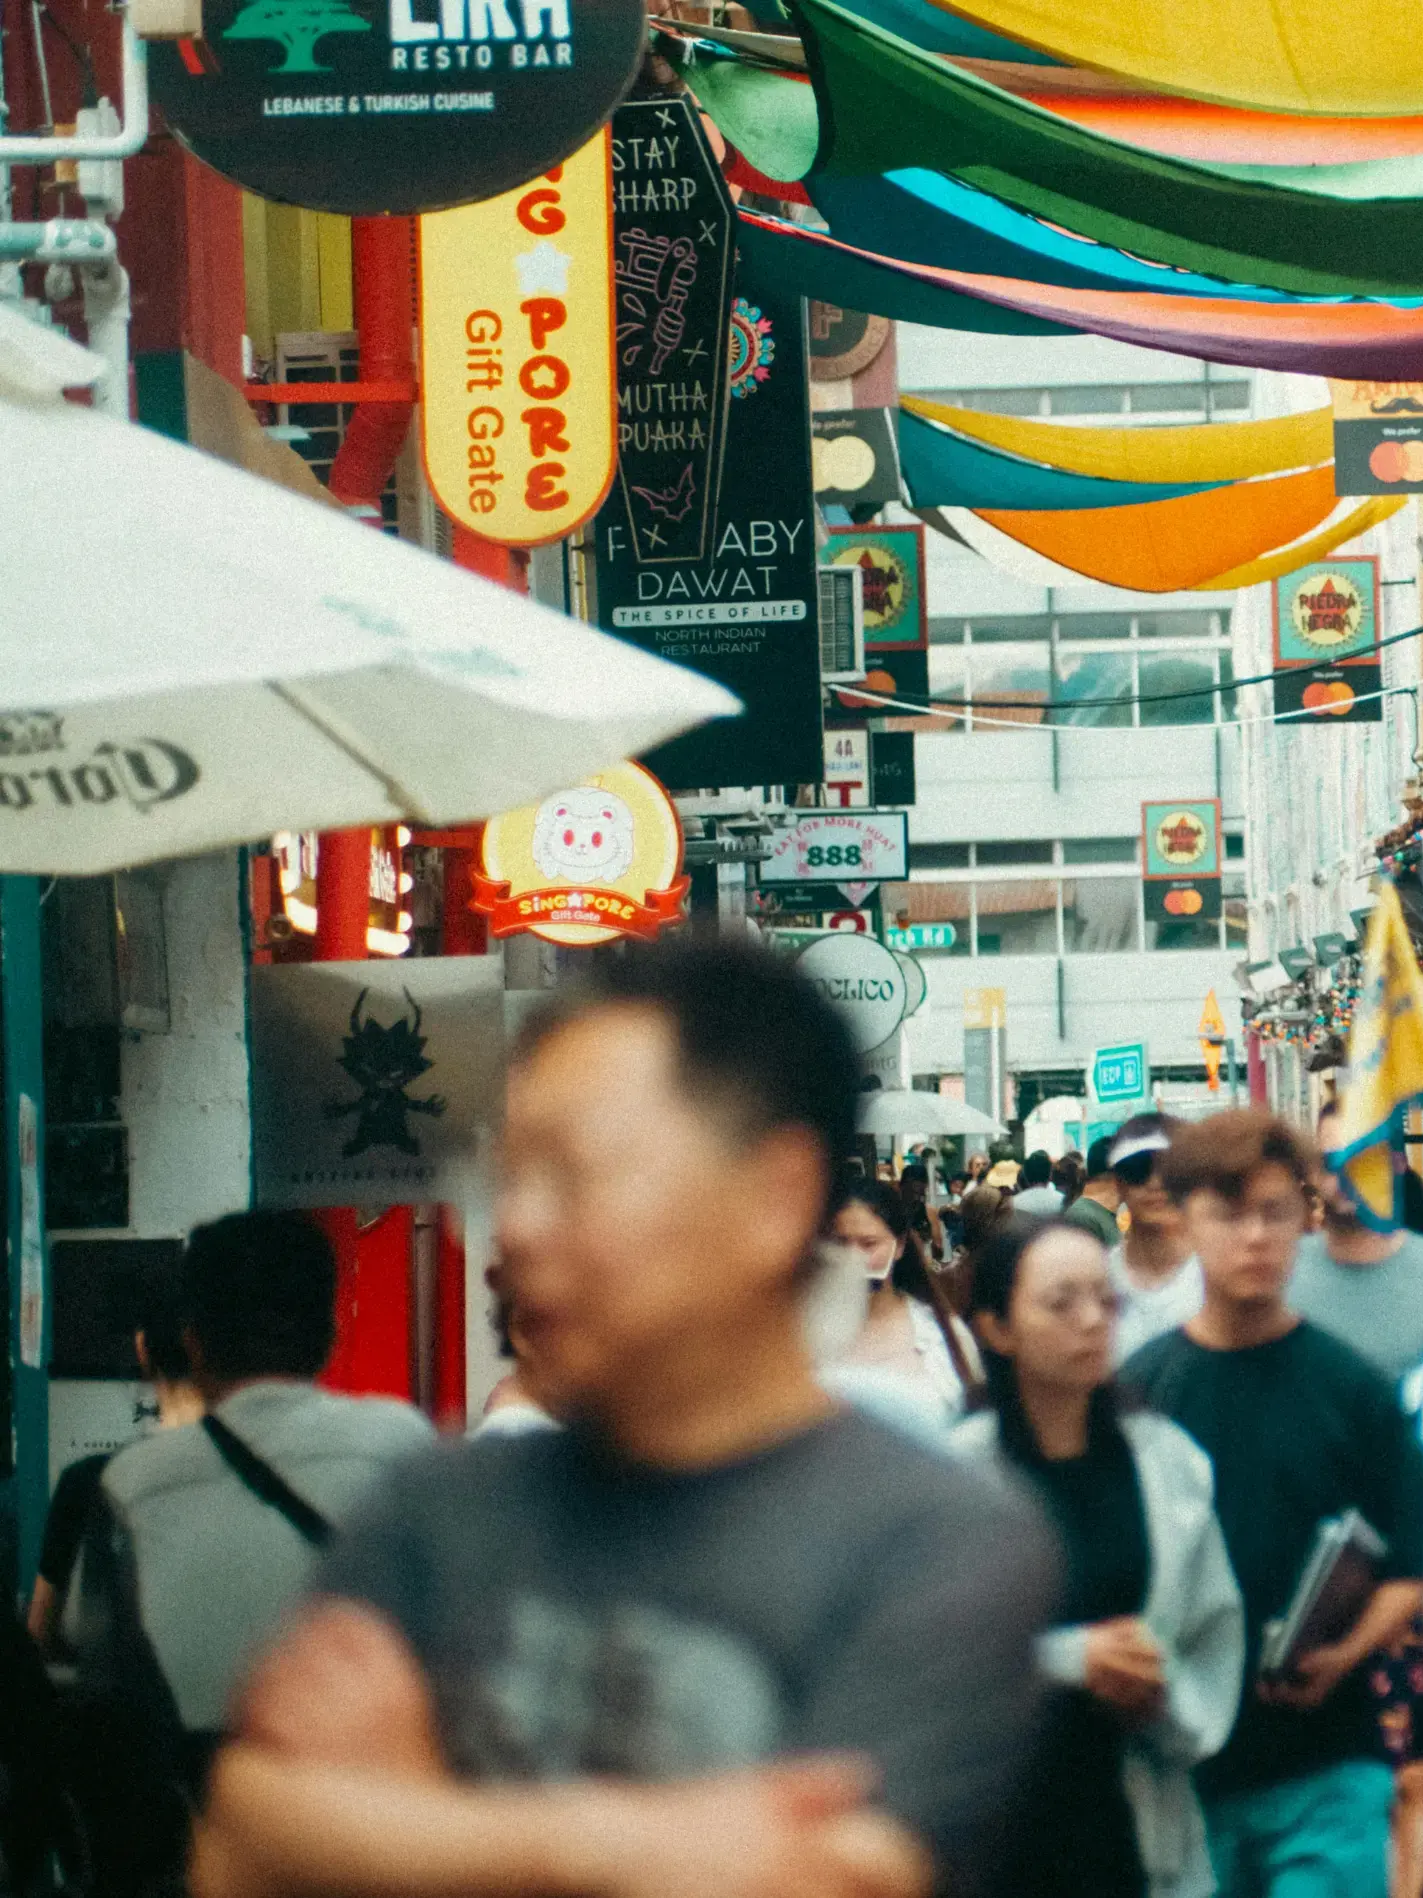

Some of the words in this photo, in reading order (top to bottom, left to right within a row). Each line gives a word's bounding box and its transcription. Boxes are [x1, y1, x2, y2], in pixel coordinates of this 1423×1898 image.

[391, 45, 493, 70] RESTO
[511, 43, 572, 67] BAR
[263, 97, 345, 116] LEBANESE
[348, 97, 359, 113] &
[364, 95, 430, 113] TURKISH
[433, 92, 494, 110] CUISINE
[613, 177, 697, 213] HARP
[465, 308, 503, 394] Gift
[618, 419, 706, 453] PUAKA
[466, 405, 505, 514] Gate
[637, 566, 778, 600] DAWAT
[1299, 592, 1356, 610] PIEDRA
[619, 610, 653, 623] THE
[664, 608, 717, 622] SPICE
[728, 606, 749, 618] OF
[761, 604, 801, 617] LIFE
[654, 628, 711, 642] NORTH
[713, 626, 766, 640] INDIAN
[661, 641, 761, 656] RESTAURANT
[795, 821, 820, 837] FOR
[823, 816, 863, 830] MORE
[807, 845, 862, 867] 888
[550, 910, 573, 920] Gift
[574, 910, 601, 921] Gate
